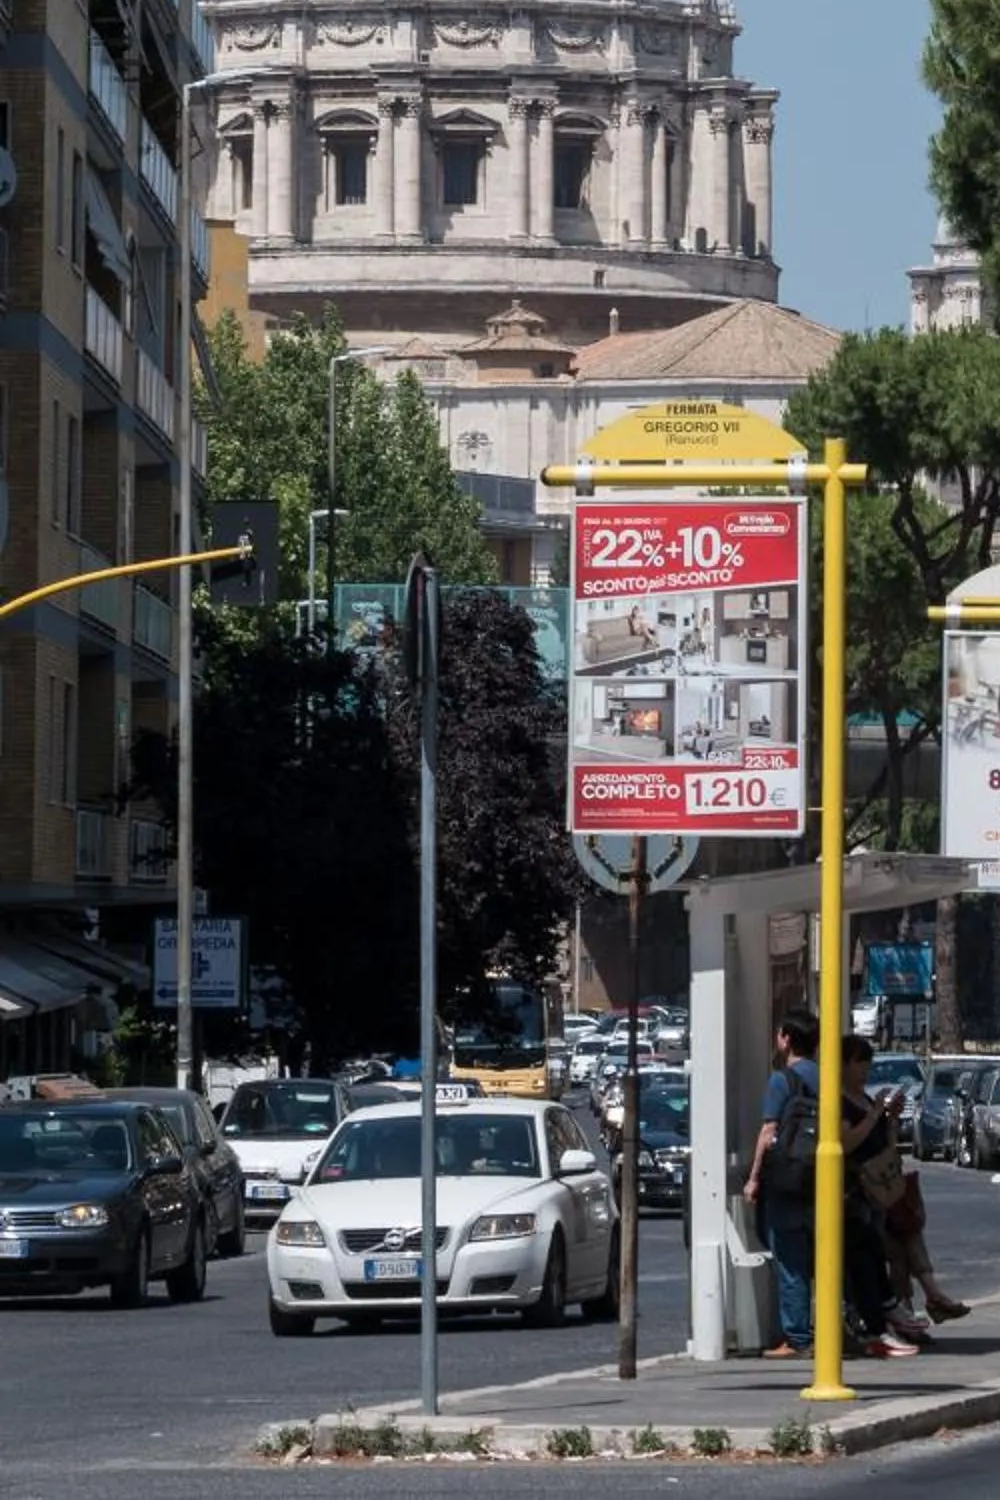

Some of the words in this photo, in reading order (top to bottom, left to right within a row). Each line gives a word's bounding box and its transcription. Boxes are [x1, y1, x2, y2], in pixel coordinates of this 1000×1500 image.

[666, 403, 717, 415] FERMATA
[643, 421, 719, 433] GREGORIO
[723, 421, 740, 432] VII
[643, 530, 663, 541] IVA
[582, 773, 665, 783] ARREDAMENTO
[581, 784, 681, 800] COMPLETO
